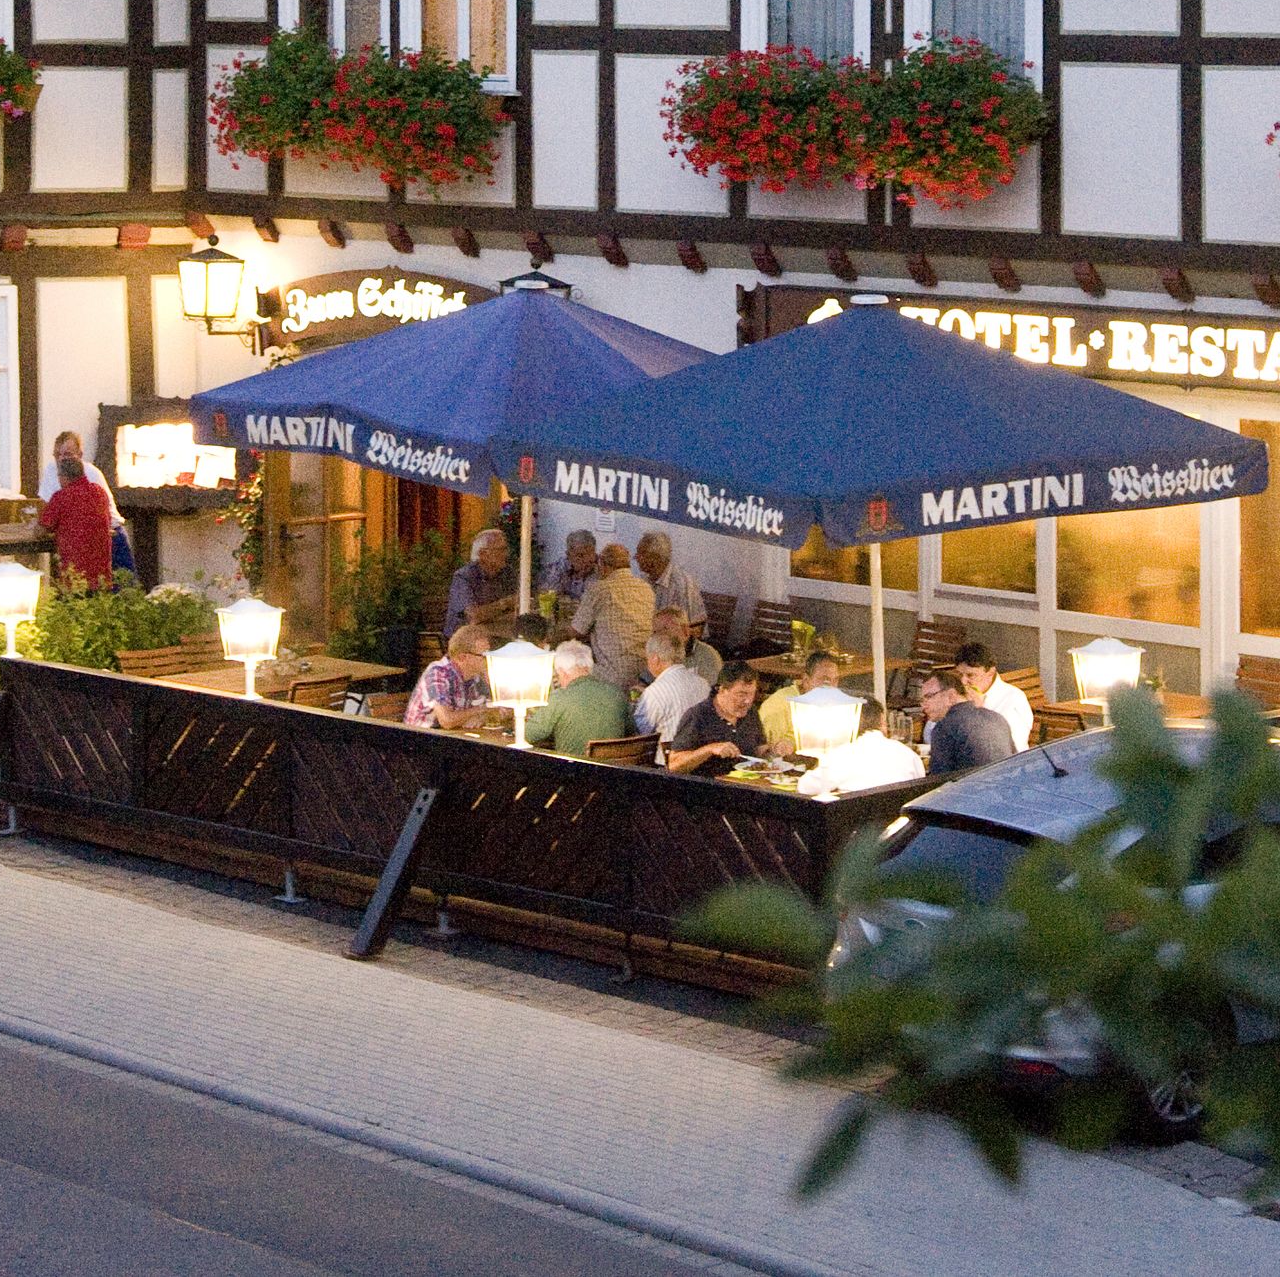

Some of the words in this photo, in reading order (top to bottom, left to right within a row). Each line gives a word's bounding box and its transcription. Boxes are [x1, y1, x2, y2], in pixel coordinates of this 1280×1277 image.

[281, 288, 355, 334] Zum
[899, 306, 1089, 368] OTEL
[245, 414, 356, 455] MARTINI
[365, 429, 471, 484] Weissbier
[553, 460, 670, 512] MARTINI
[685, 480, 785, 537] Weissbier
[921, 472, 1085, 528] MARTINI
[1107, 457, 1237, 504] Weissbier
